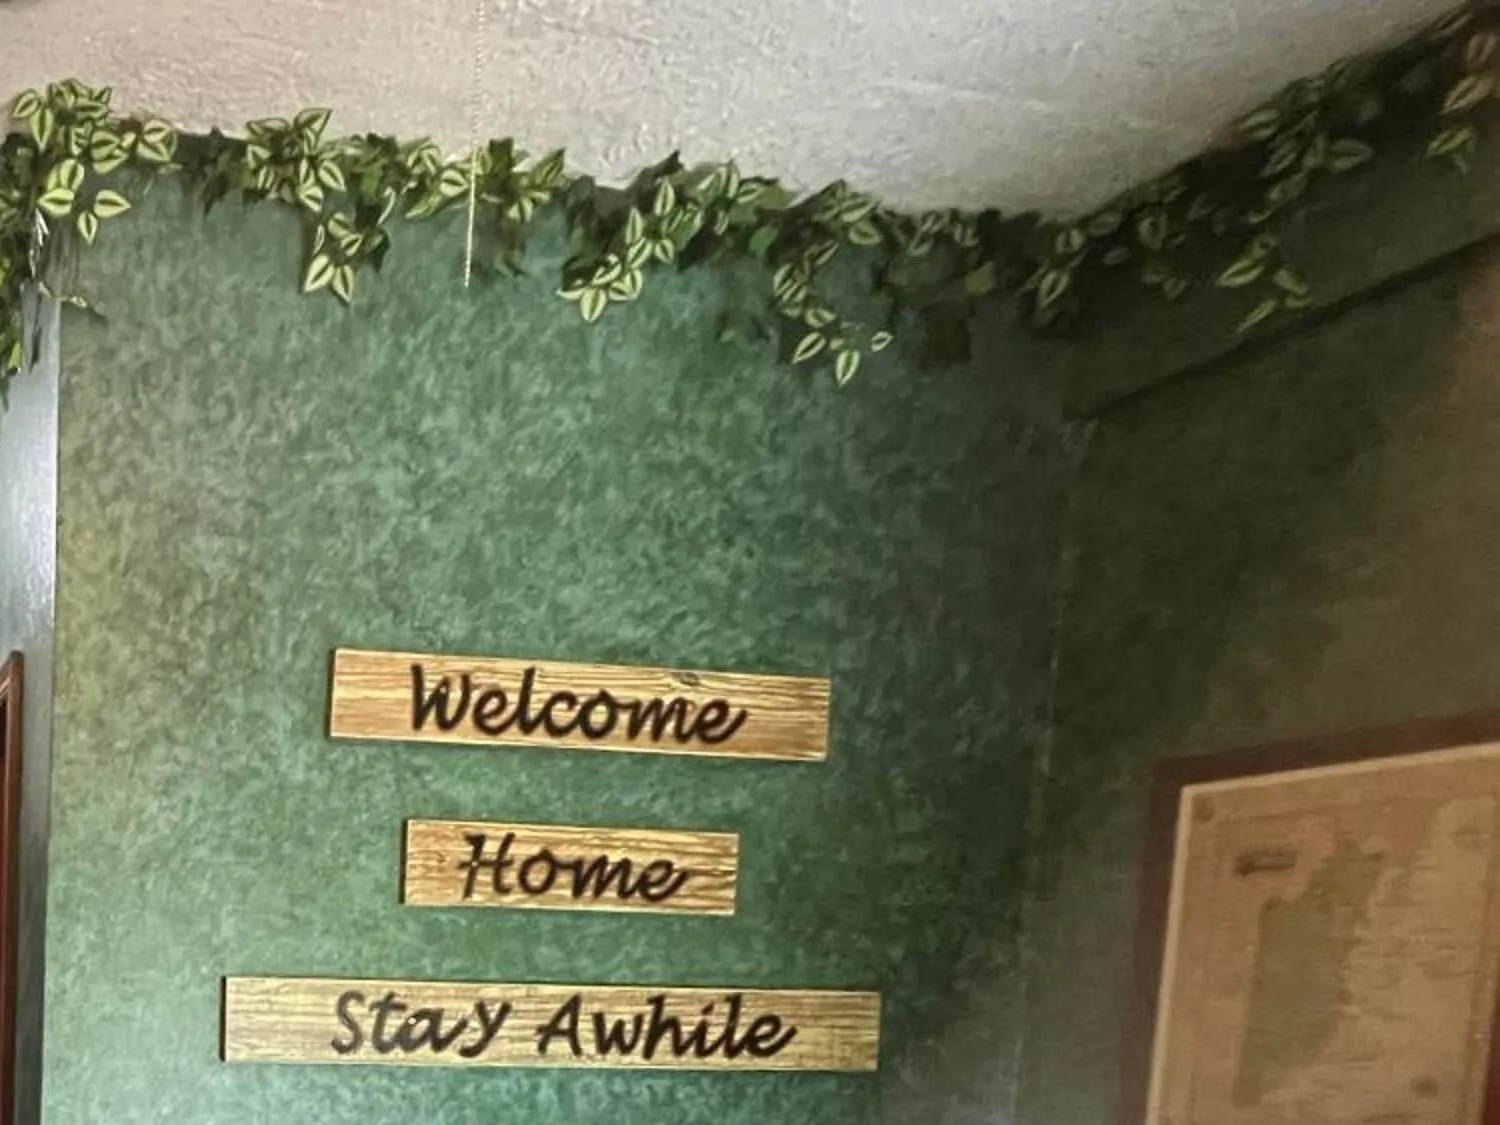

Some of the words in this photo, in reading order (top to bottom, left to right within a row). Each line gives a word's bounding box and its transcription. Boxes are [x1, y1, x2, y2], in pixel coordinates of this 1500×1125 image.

[411, 664, 749, 744] Welcome
[458, 832, 689, 902] Home
[331, 992, 512, 1059] Stay
[535, 994, 798, 1060] Awhile
